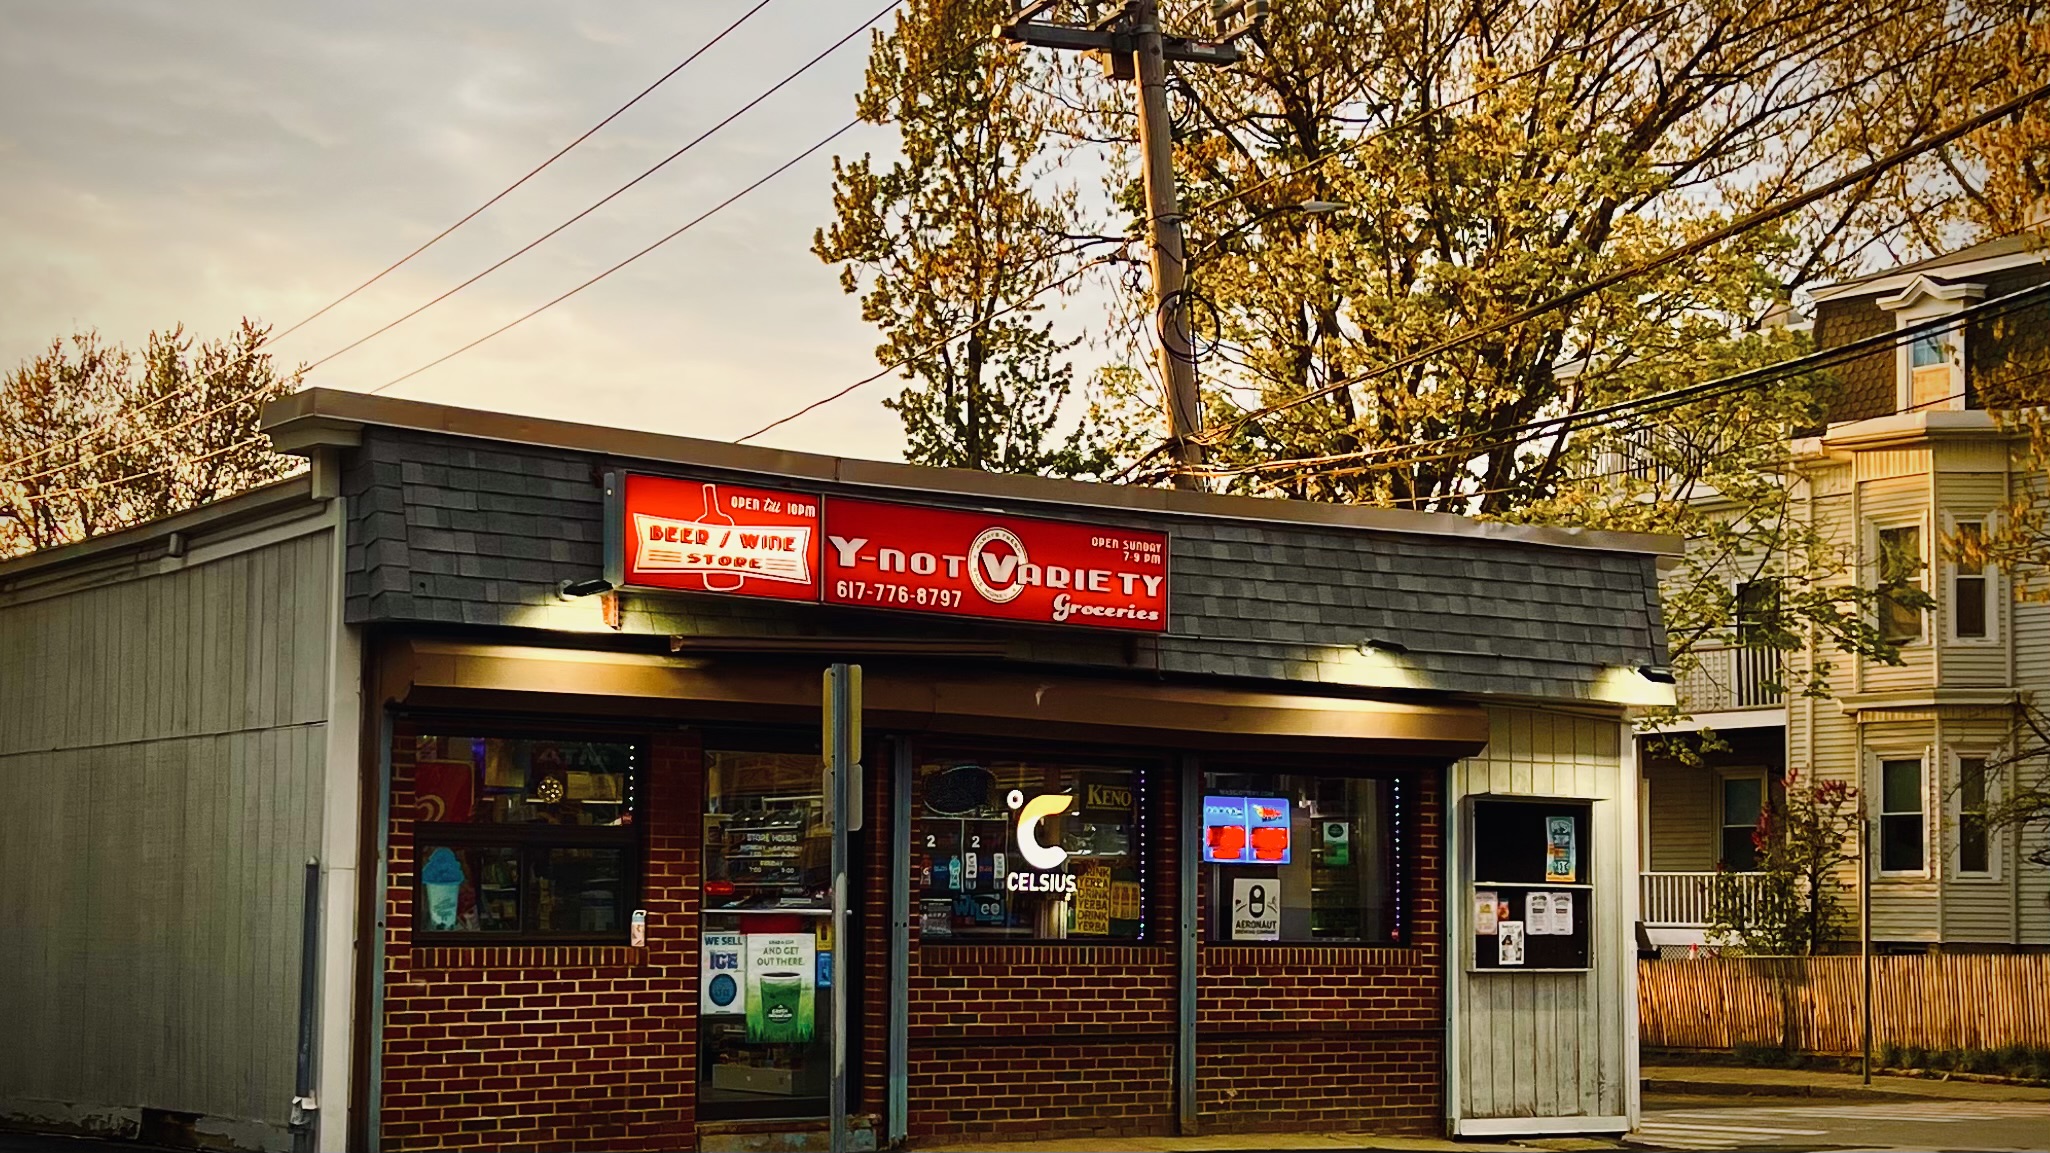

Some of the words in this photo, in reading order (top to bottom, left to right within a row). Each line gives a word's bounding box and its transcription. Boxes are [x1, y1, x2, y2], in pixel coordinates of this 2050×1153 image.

[731, 496, 760, 511] OPEN
[763, 497, 781, 513] till
[650, 525, 710, 546] BEER
[739, 533, 798, 552] WINE
[1091, 536, 1119, 549] OPEN
[1122, 540, 1162, 553] SUNDAY
[687, 553, 763, 569] STORE
[1123, 551, 1140, 563] 7-9
[1143, 553, 1161, 565] PM
[981, 551, 1164, 597] VARIETY
[836, 580, 962, 608] 617-776-8797
[1052, 593, 1159, 622] Groceries
[771, 834, 798, 842] HOURS
[926, 834, 936, 848] 2
[971, 835, 981, 849] 2
[1085, 867, 1111, 878] RINK
[1006, 871, 1077, 893] CELSIUS
[1078, 888, 1109, 899] DRINK
[1078, 899, 1108, 910] YERBA
[1077, 910, 1108, 921] DRINK
[1077, 921, 1107, 932] YERBA
[1235, 920, 1277, 929] AERONAUT
[705, 936, 719, 945] WE
[721, 936, 743, 946] SELL
[763, 946, 782, 955] AND
[783, 946, 799, 955] GET
[709, 951, 739, 970] ICE
[756, 957, 774, 967] OUT
